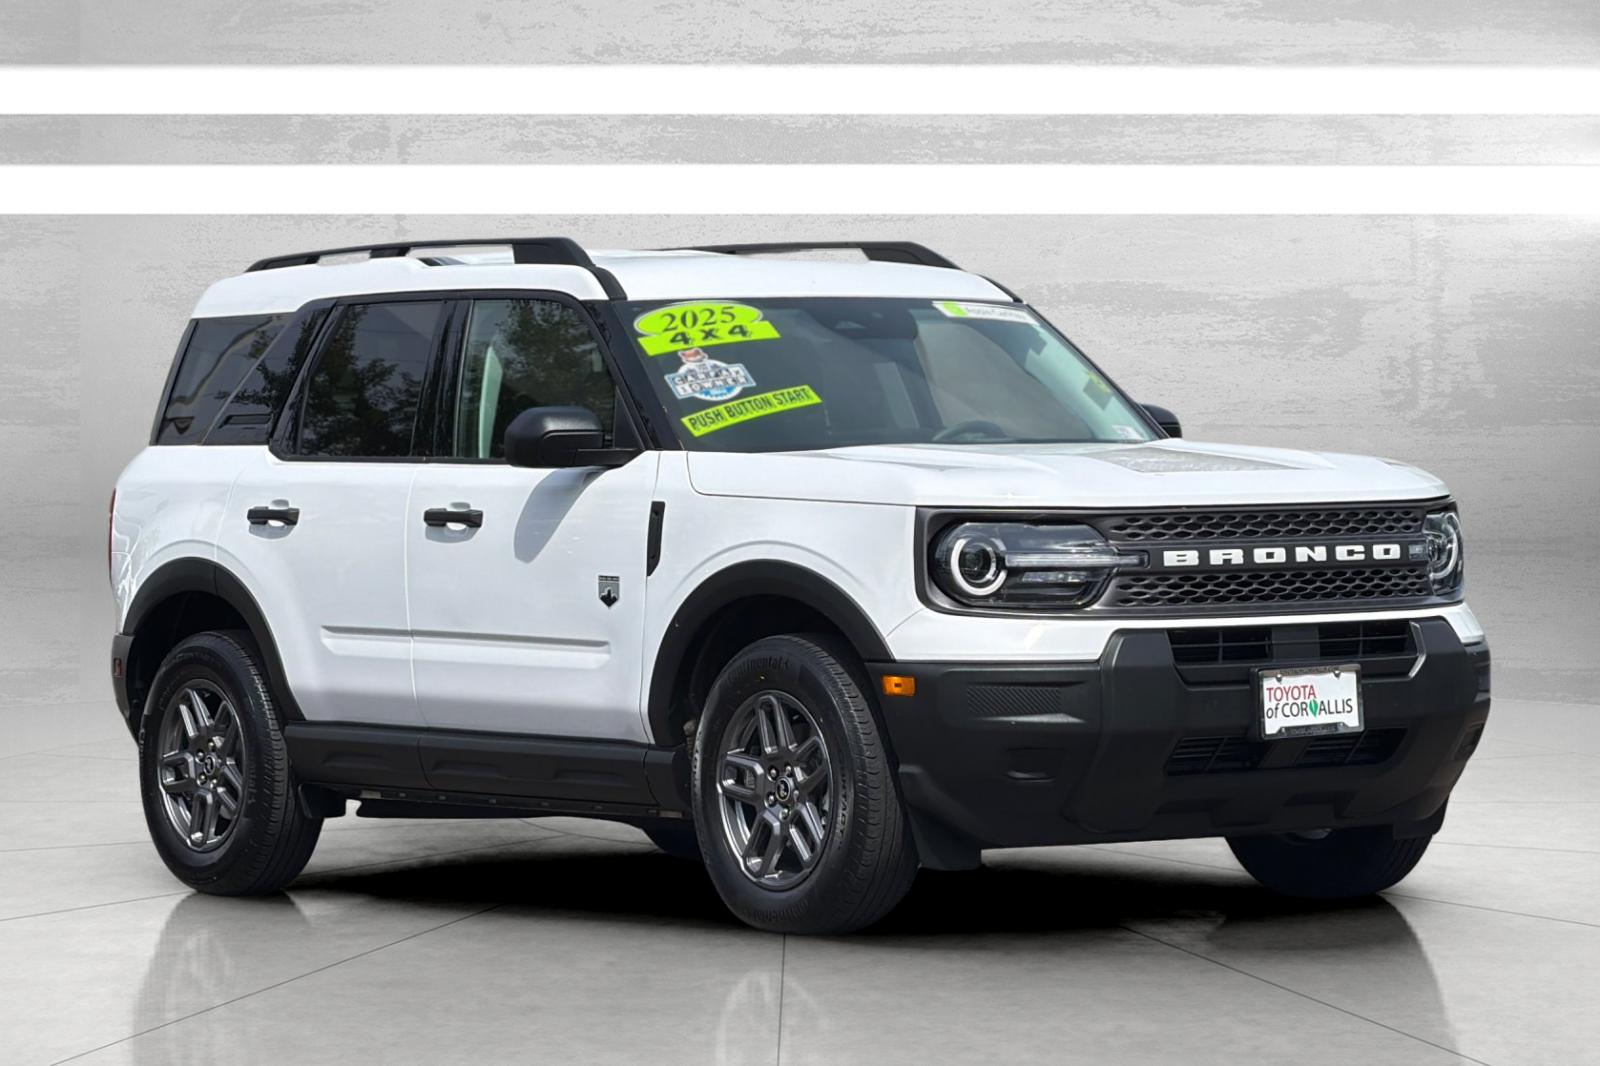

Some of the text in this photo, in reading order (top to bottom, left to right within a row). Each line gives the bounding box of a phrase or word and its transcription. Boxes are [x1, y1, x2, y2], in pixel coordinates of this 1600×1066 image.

[661, 306, 736, 332] 2025
[688, 387, 810, 431] PUSH BUTTON START
[1163, 544, 1401, 567] BRONCO
[1266, 685, 1317, 702] TOYOTA
[1266, 703, 1280, 719] of
